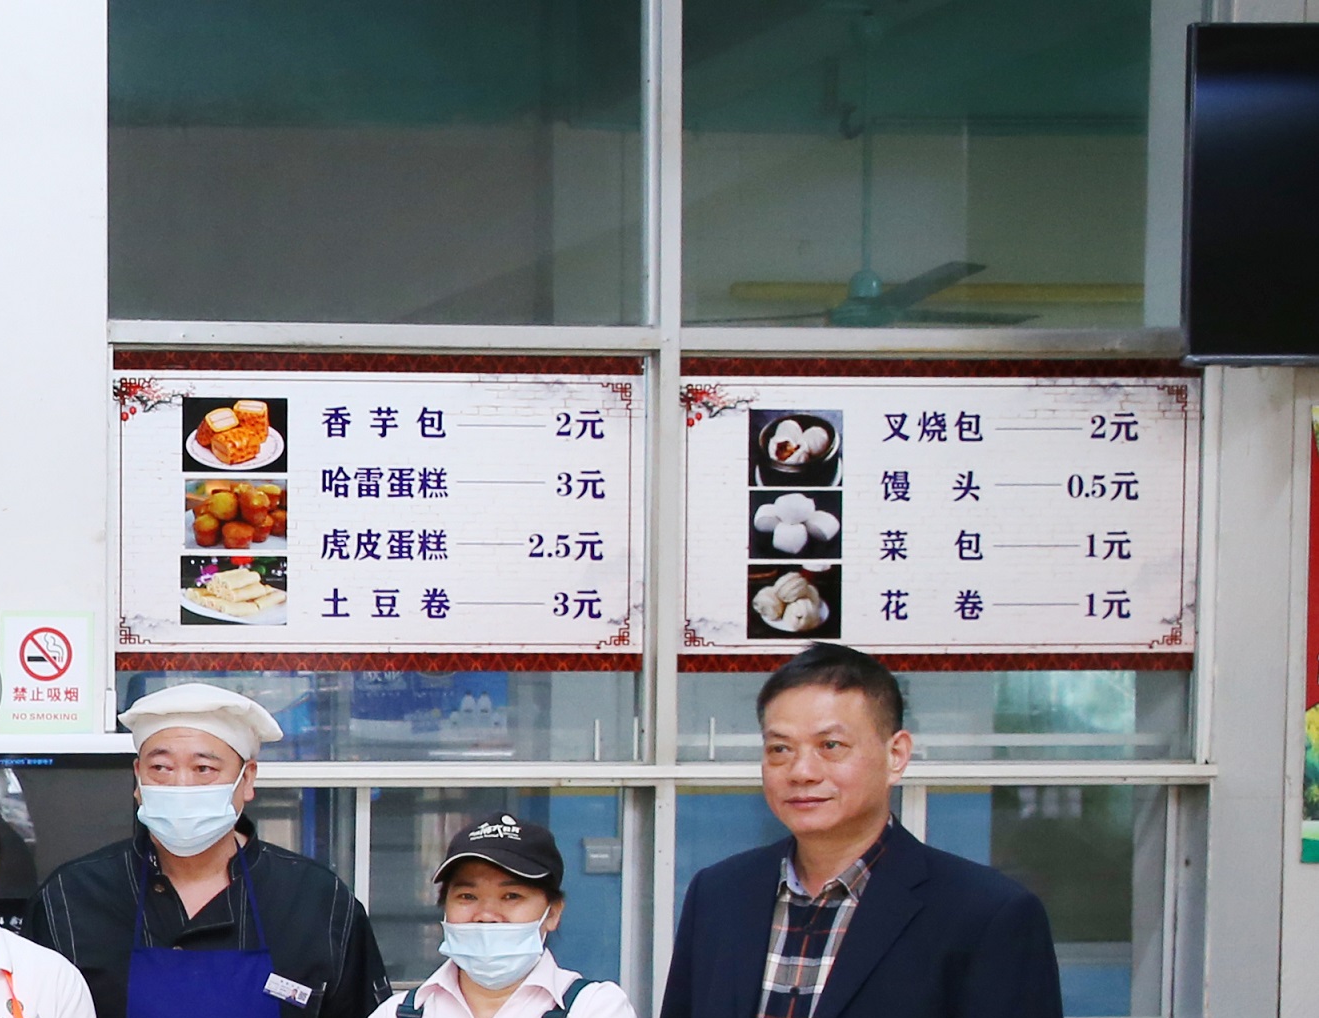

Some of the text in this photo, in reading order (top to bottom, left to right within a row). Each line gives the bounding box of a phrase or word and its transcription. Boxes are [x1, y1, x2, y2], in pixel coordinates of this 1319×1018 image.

[321, 406, 605, 440] 香芋包 2元
[882, 410, 1139, 442] 叉烧包 2元
[321, 466, 606, 499] 哈雷蛋糕 3元
[880, 470, 1139, 502] 馒头 0.5元
[320, 528, 604, 561] 虎皮蛋糕 2.5元
[880, 529, 1132, 562] 菜包 1元
[321, 587, 602, 619] 土豆卷 3元
[880, 589, 1131, 621] 花卷 1元
[13, 686, 79, 702] 禁止吸烟
[12, 713, 78, 721] NO SMOKING
